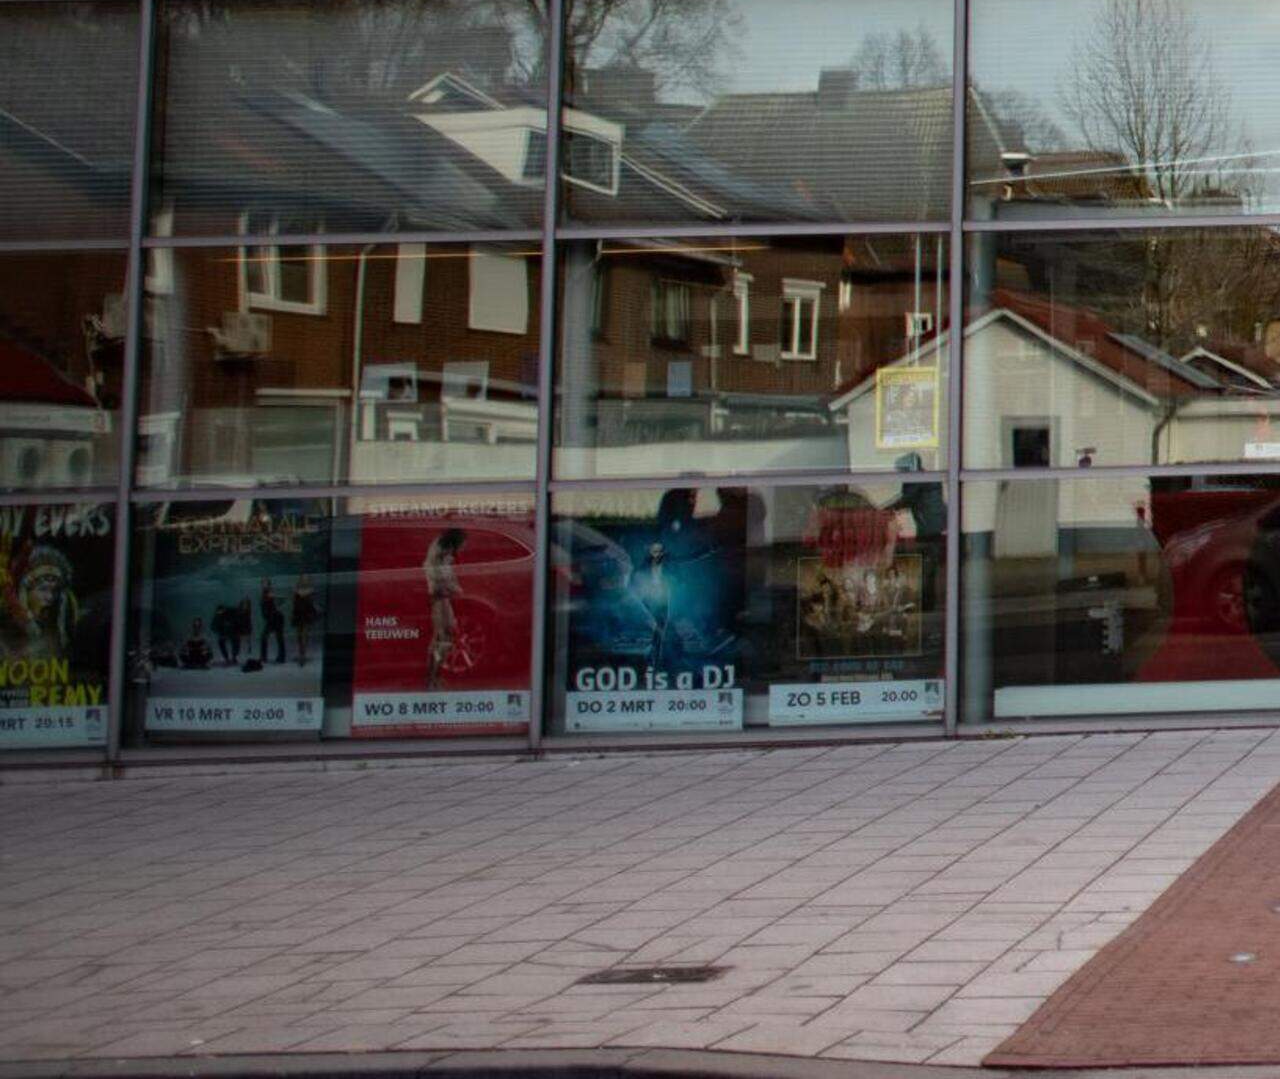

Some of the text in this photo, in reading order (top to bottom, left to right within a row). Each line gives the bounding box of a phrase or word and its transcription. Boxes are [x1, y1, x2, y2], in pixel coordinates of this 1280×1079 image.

[365, 616, 398, 627] HANS
[365, 628, 419, 640] TEEUWEN
[575, 664, 735, 691] GOD is a DJ
[30, 682, 102, 709] REMY
[787, 692, 812, 707] ZO
[816, 692, 826, 706] 5
[830, 691, 861, 706] FEB
[154, 707, 175, 721] VR
[179, 707, 196, 720] 10
[199, 707, 234, 721] MRT
[365, 703, 394, 716] WO
[399, 702, 408, 715] 8
[412, 701, 447, 715] MRT
[577, 701, 602, 714] DO
[606, 700, 616, 714] 2
[620, 700, 655, 714] MRT
